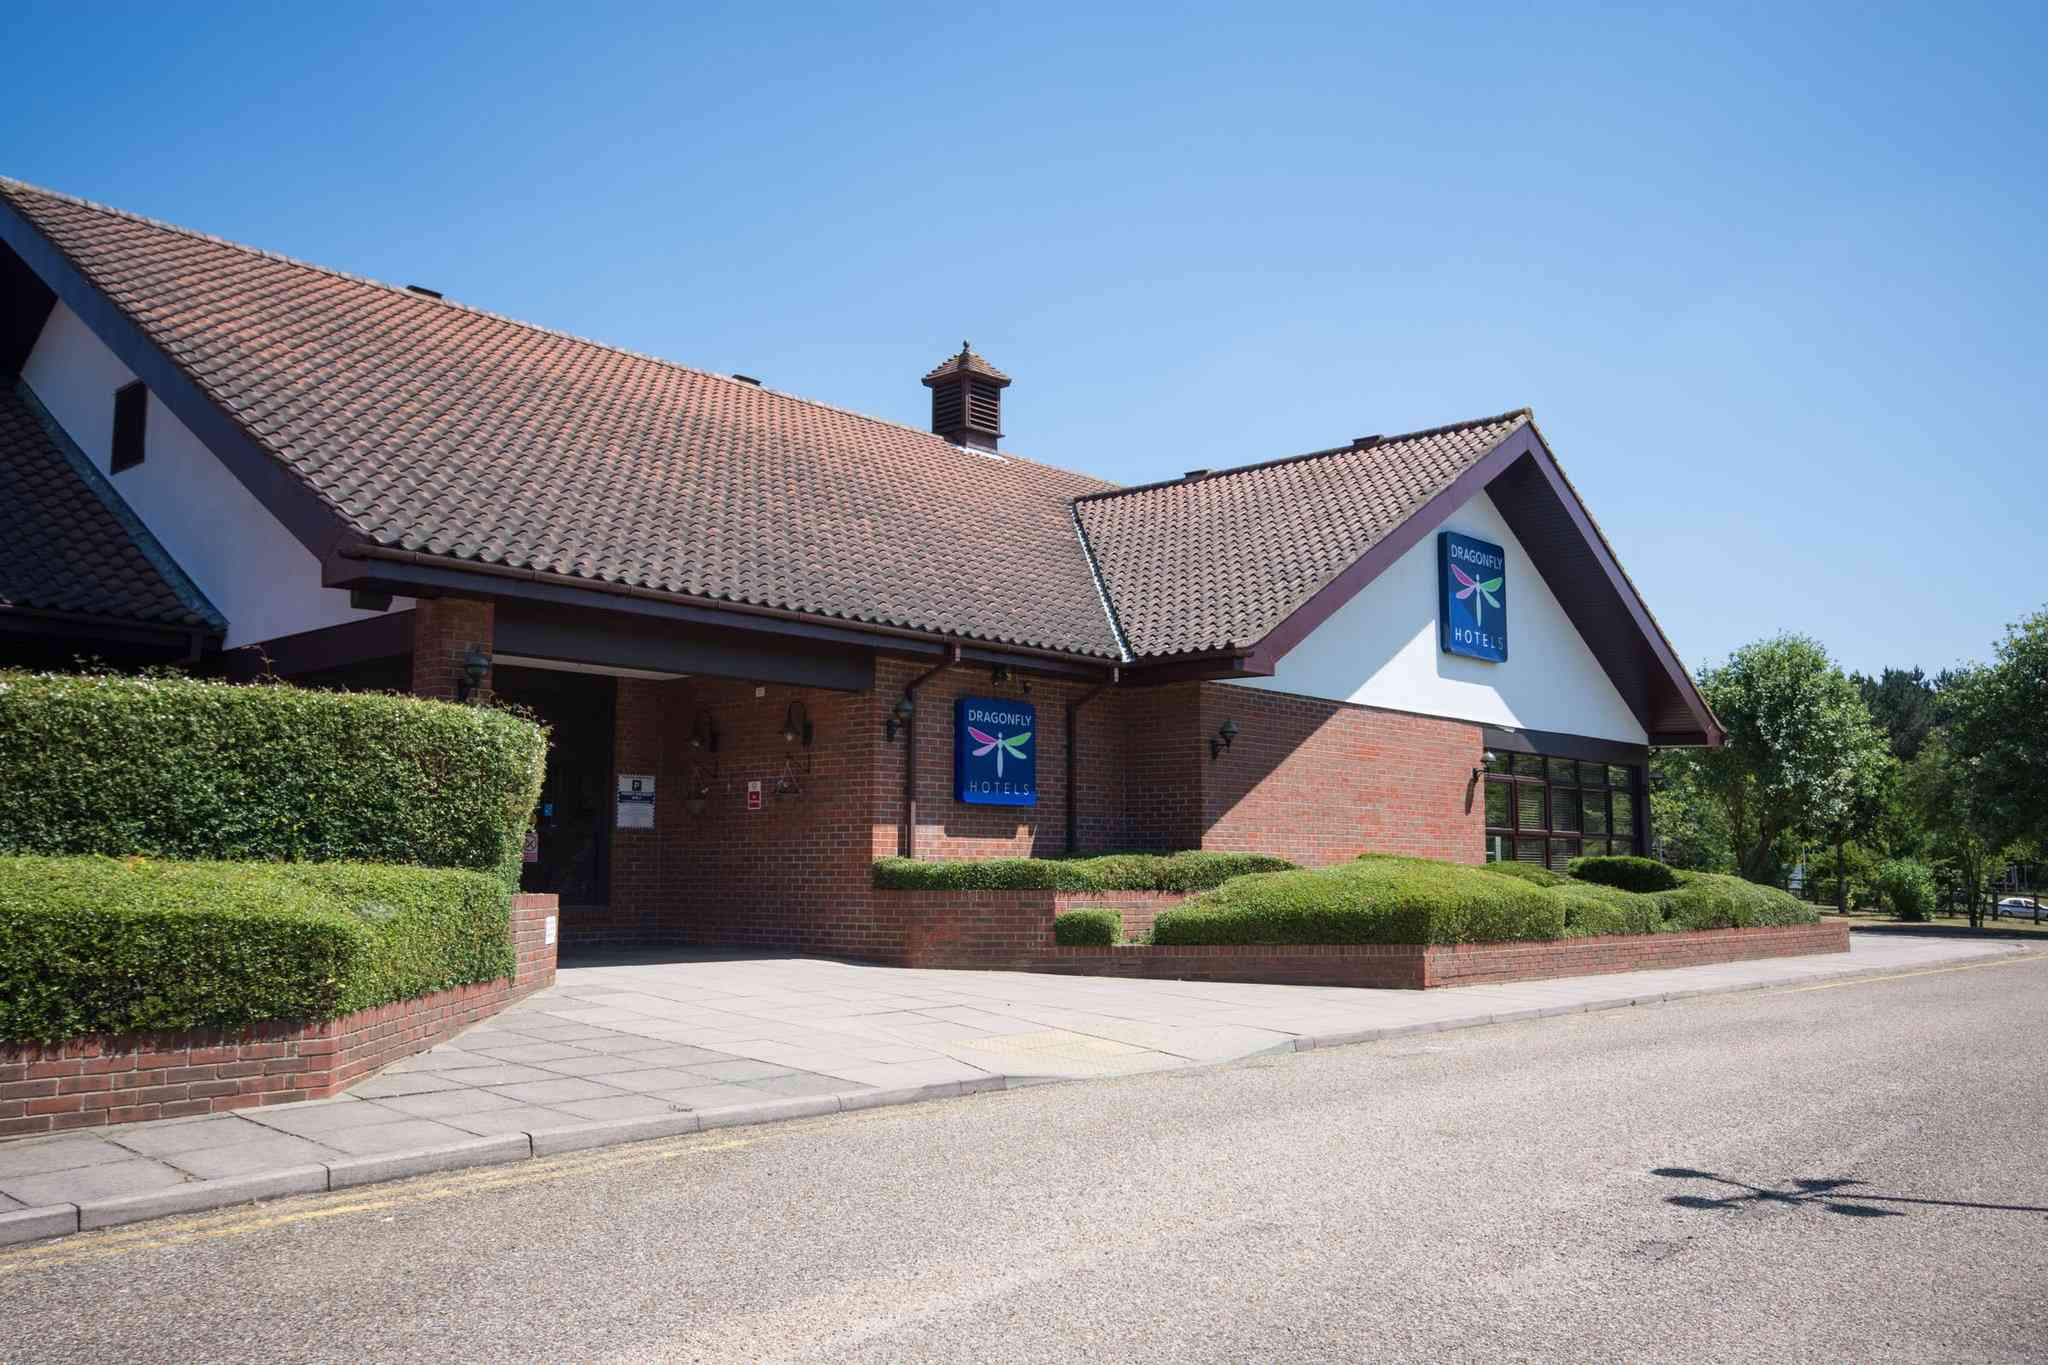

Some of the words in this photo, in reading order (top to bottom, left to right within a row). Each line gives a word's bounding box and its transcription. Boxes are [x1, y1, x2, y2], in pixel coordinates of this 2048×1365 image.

[1451, 544, 1503, 569] DRAGONFLY
[1455, 627, 1504, 649] HOTELS
[968, 709, 1032, 726] DRAGONFLY
[969, 781, 1029, 796] HOTELS
